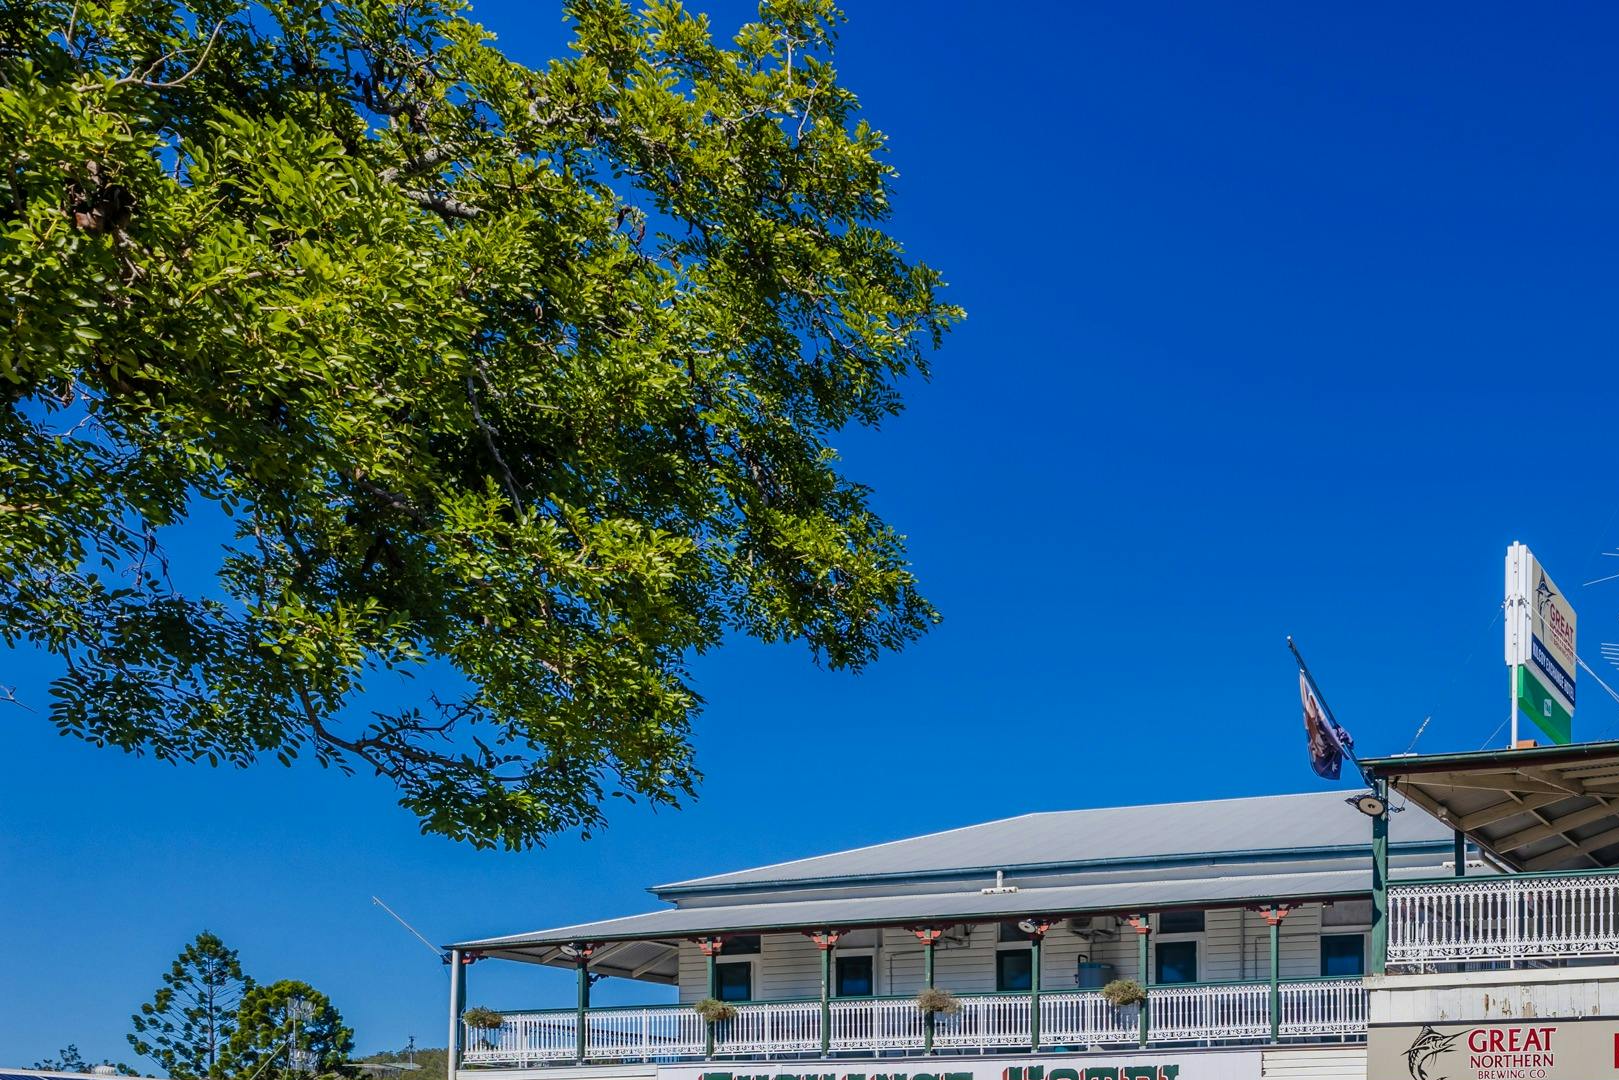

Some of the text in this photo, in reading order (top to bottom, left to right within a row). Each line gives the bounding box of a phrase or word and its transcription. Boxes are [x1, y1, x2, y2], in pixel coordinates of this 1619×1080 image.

[1549, 603, 1574, 644] GREAT
[1467, 1027, 1557, 1053] GREAT
[1470, 1053, 1554, 1069] NORTHERN
[1478, 1069, 1548, 1080] BREWING CO.
